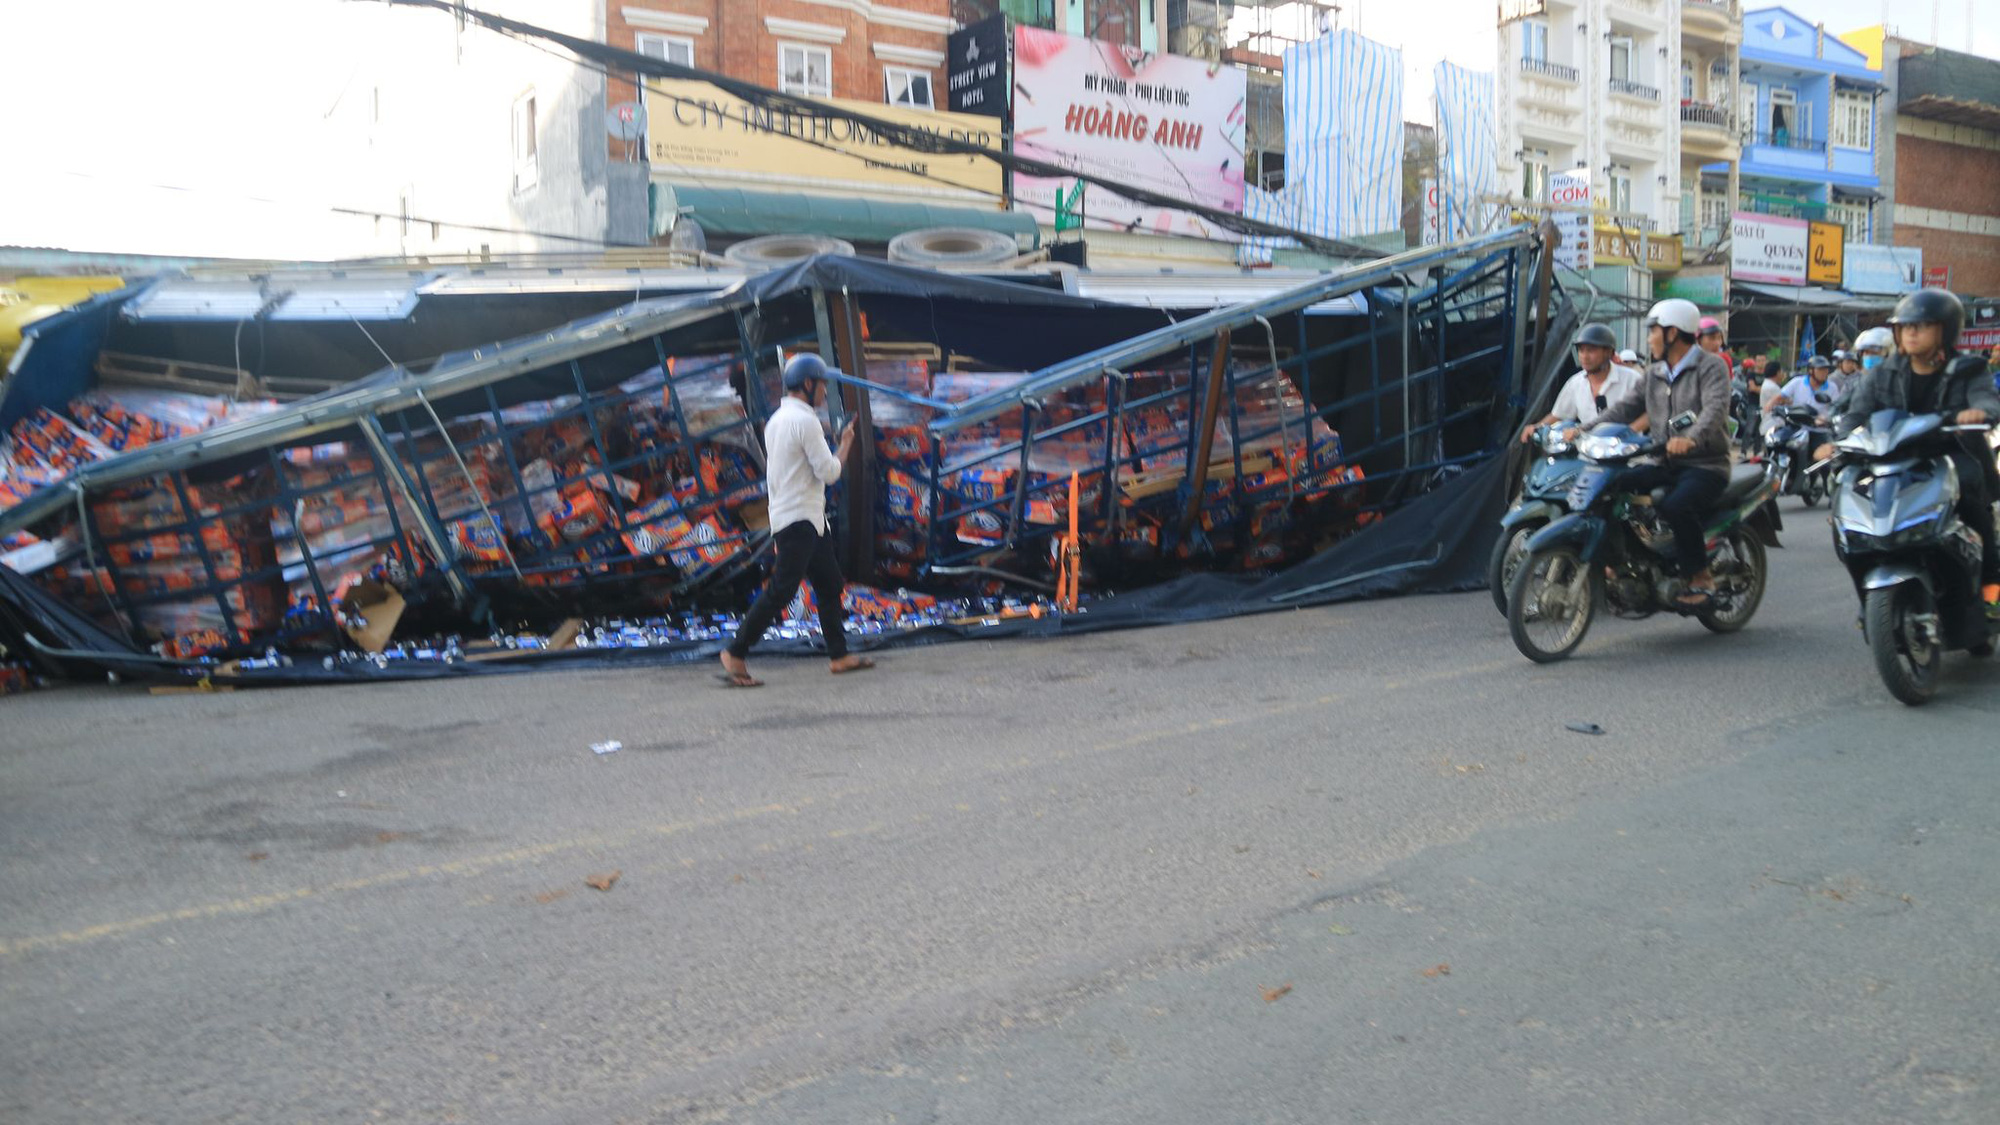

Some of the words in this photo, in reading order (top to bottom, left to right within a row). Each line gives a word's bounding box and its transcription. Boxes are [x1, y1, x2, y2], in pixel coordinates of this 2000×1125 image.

[978, 60, 996, 80] VIEW
[962, 87, 984, 108] HOTEL
[1175, 87, 1190, 107] TÓC
[673, 97, 728, 131] CTY
[1064, 100, 1149, 142] HOÀNG
[1153, 117, 1203, 151] ANH
[1552, 185, 1589, 204] CƠM
[1625, 240, 1665, 263] HOEL
